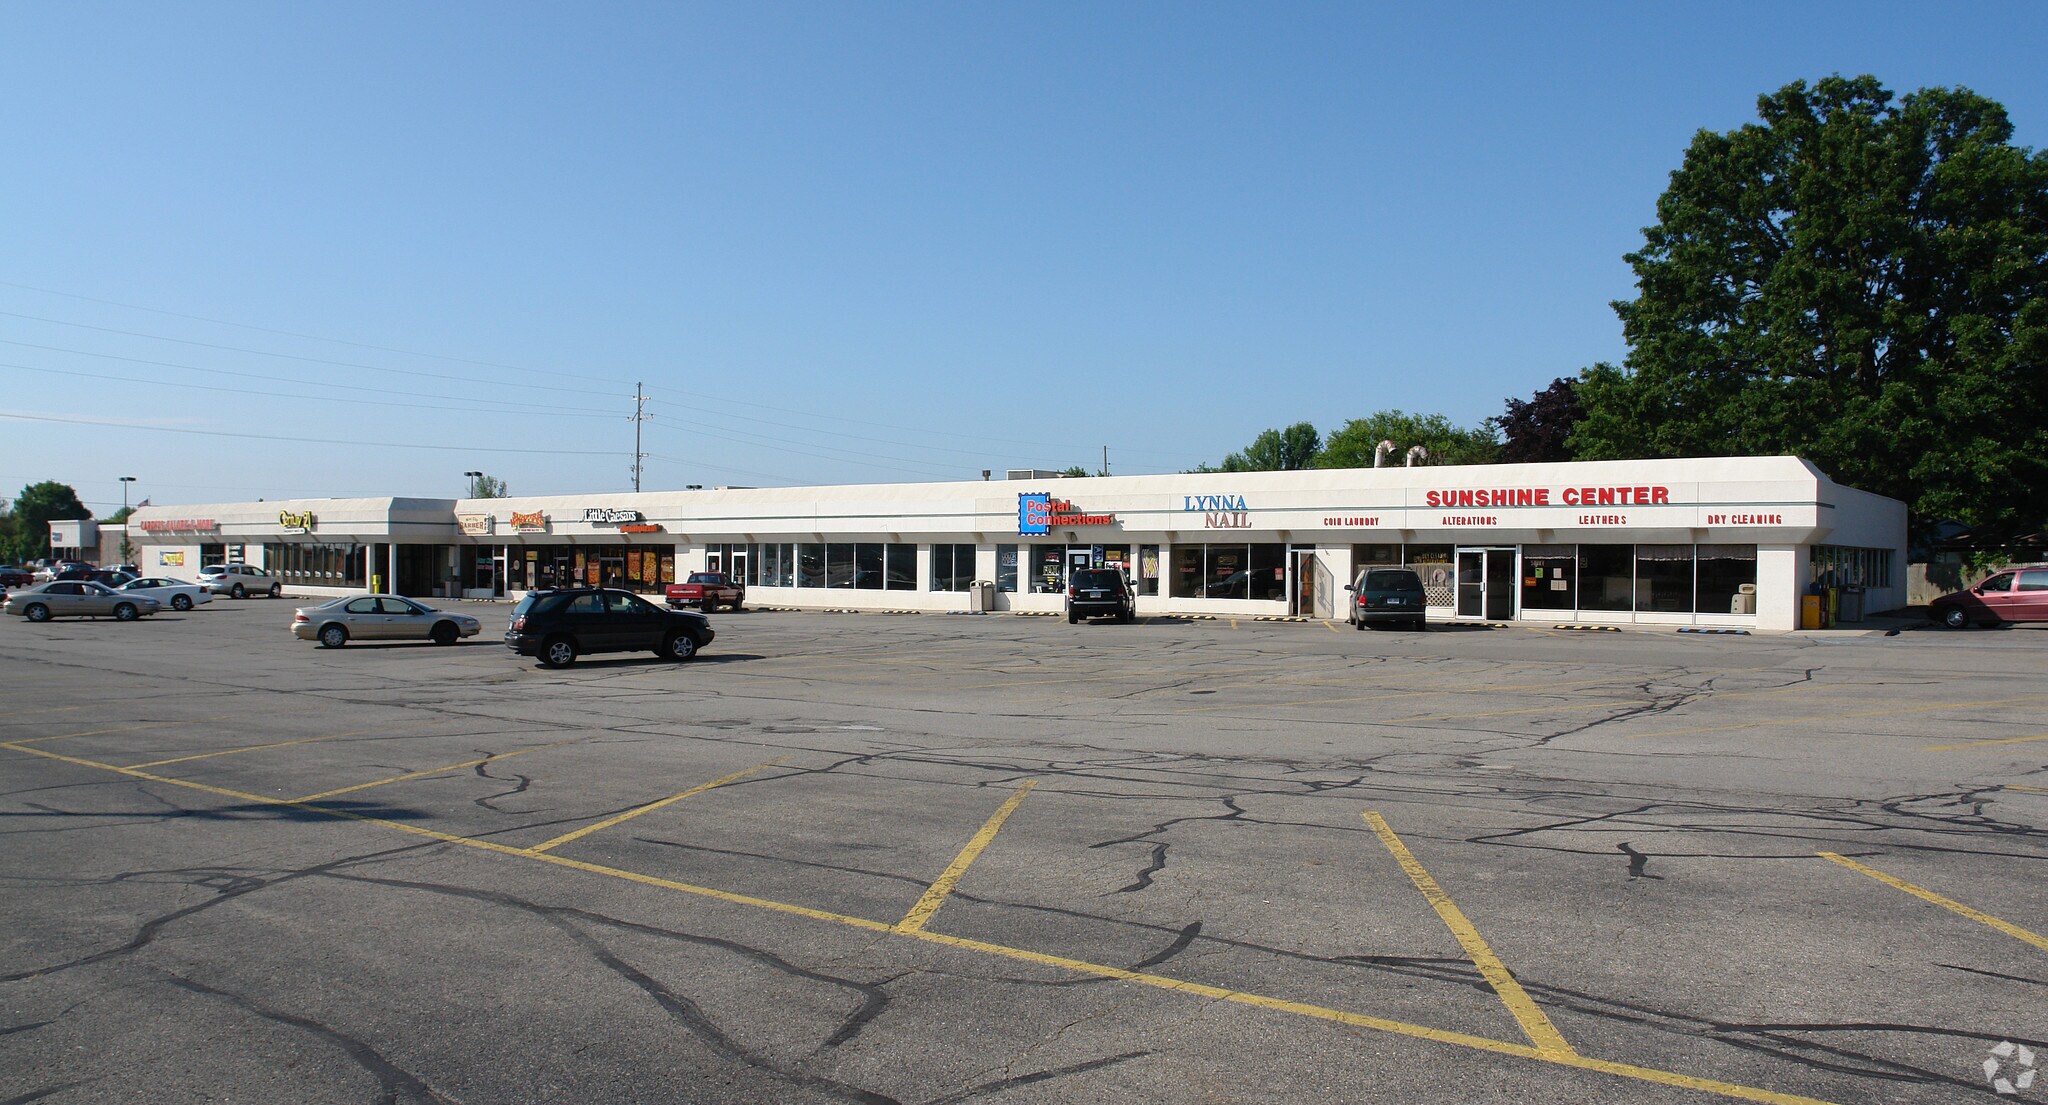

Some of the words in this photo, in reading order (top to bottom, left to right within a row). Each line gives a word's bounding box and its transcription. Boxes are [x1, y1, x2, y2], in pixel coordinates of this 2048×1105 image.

[1183, 494, 1248, 511] LYNNA
[1426, 488, 1550, 507] SUNSHINE
[1562, 486, 1670, 506] CENTER
[1026, 499, 1070, 512] Postal
[583, 508, 605, 522] Little
[605, 508, 638, 523] Caesars
[1026, 512, 1112, 526] Connections
[1204, 511, 1252, 528] NAIL
[1323, 517, 1342, 526] COIN
[1344, 517, 1380, 526] LAUNDRY
[1442, 516, 1498, 526] ALTERATIONS
[1578, 515, 1628, 525] LEATHERS
[1707, 514, 1727, 525] DRY
[1731, 514, 1783, 525] CLEANING
[459, 520, 484, 530] BARBER
